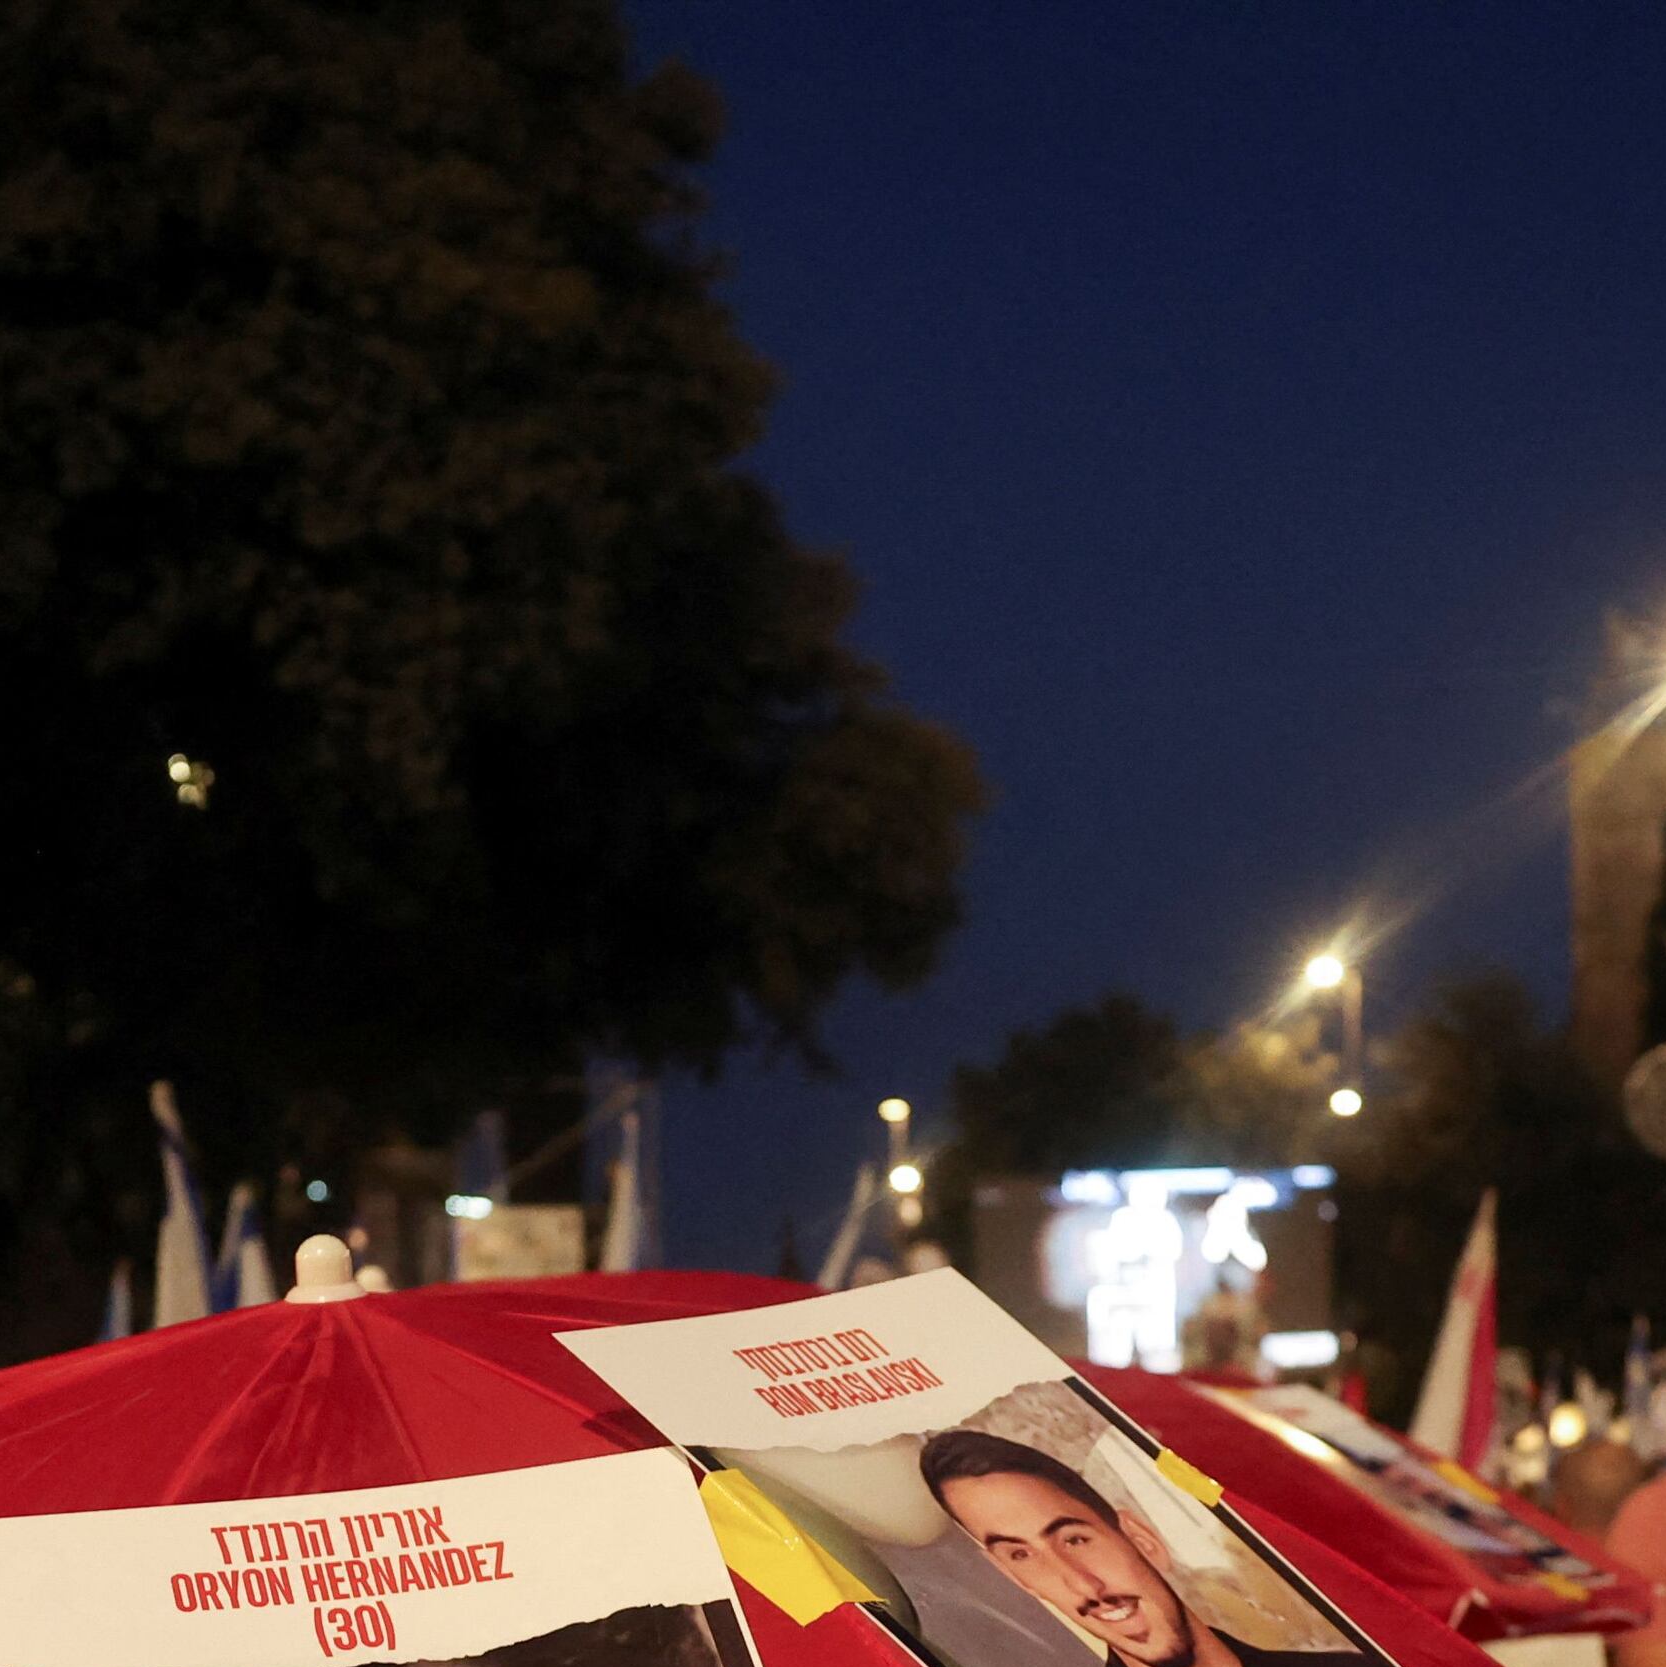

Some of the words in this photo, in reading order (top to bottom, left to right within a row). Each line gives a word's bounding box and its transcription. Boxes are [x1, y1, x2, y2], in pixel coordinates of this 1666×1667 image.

[833, 1328, 890, 1361] רום
[754, 1383, 823, 1418] ROM
[802, 1357, 944, 1411] BRASLAVSKI
[211, 1519, 334, 1565] הרננדז
[340, 1506, 451, 1558] אוריון
[170, 1566, 295, 1612] ORYON
[301, 1541, 514, 1602] HERNANDEZ
[314, 1601, 396, 1657] (30)
